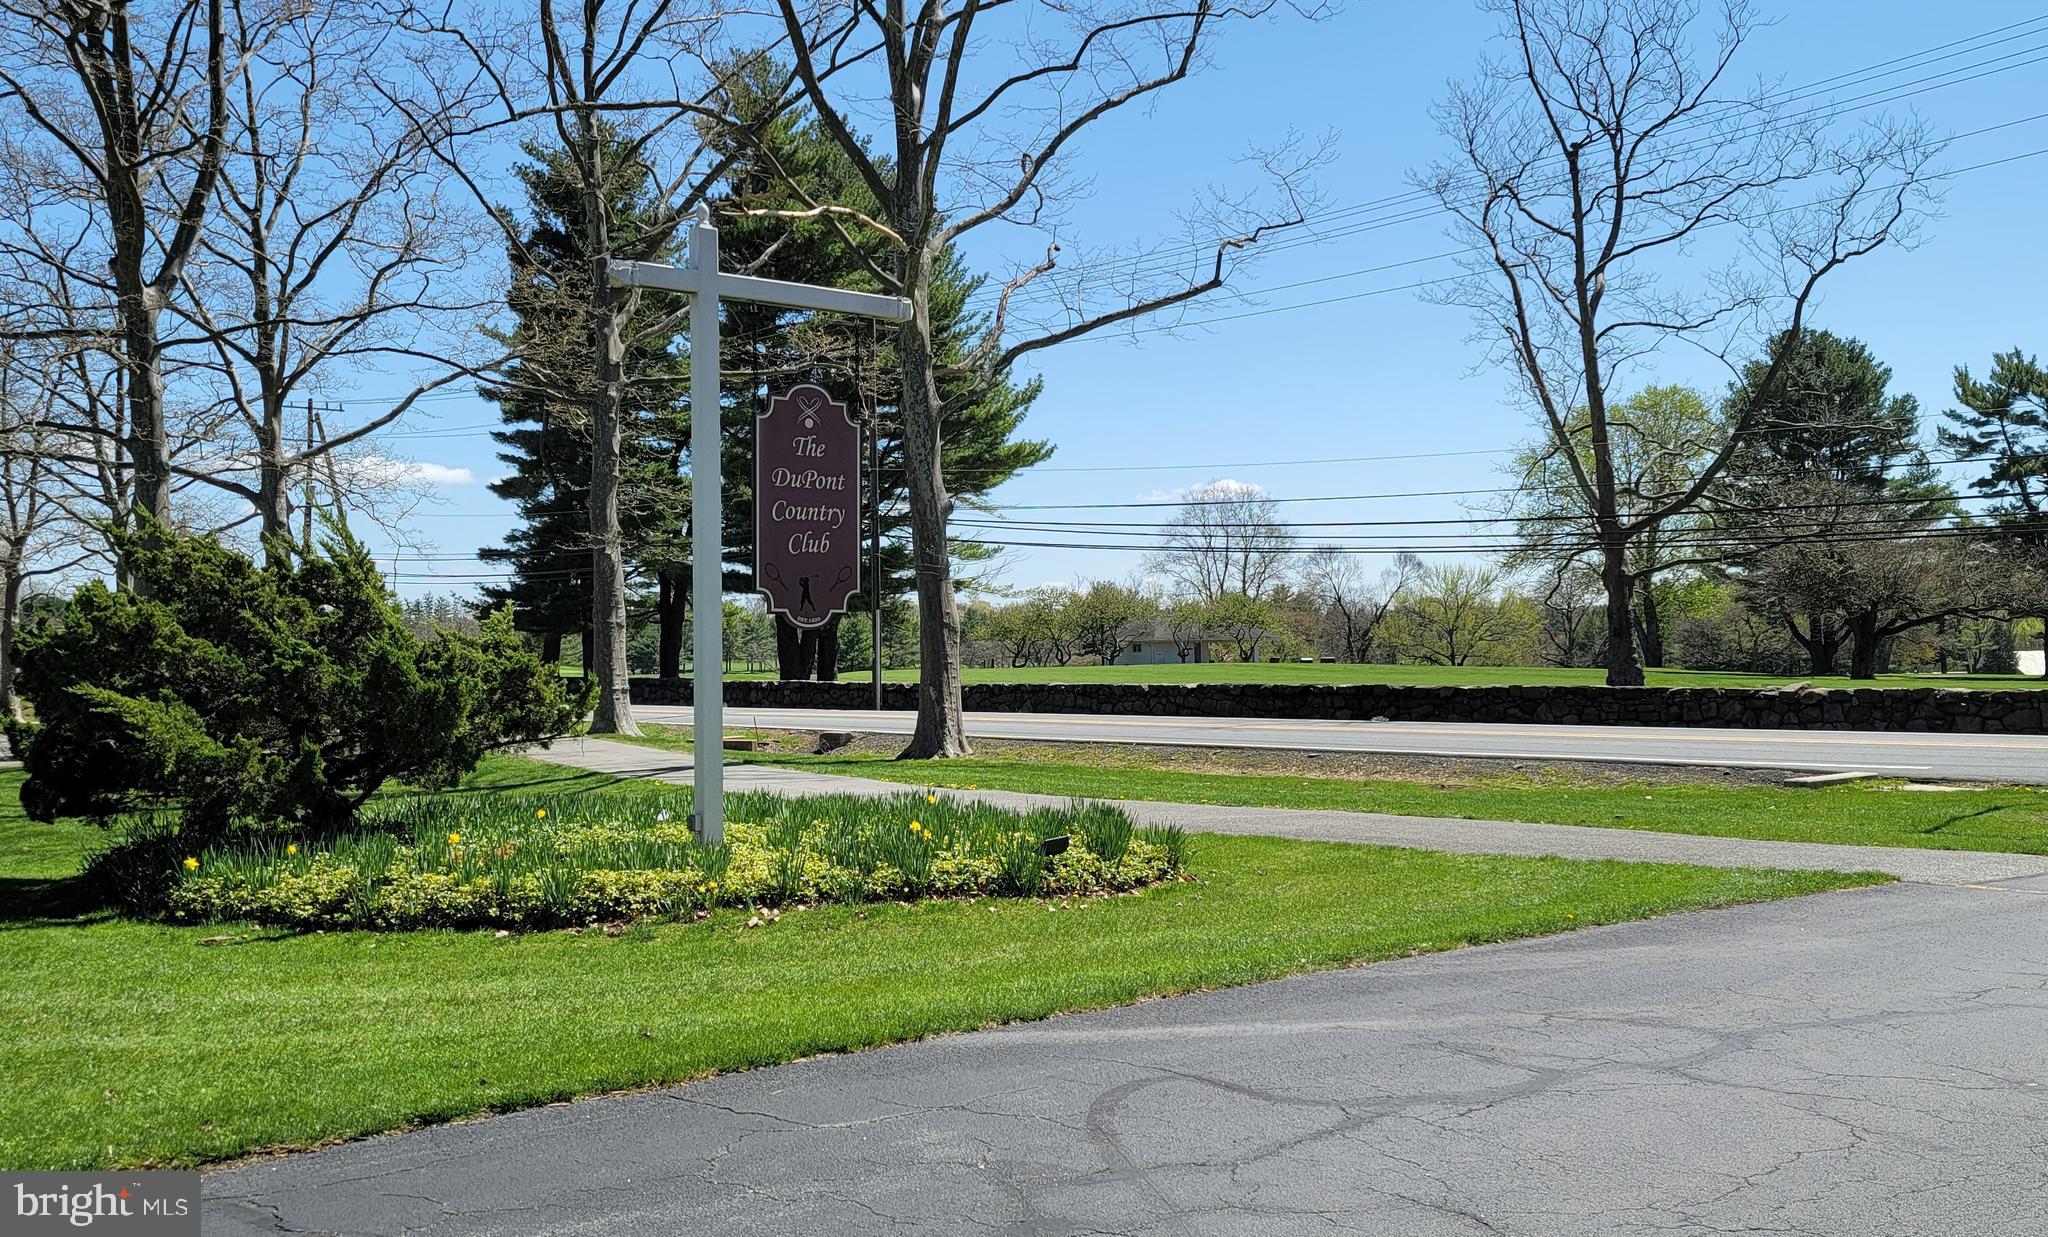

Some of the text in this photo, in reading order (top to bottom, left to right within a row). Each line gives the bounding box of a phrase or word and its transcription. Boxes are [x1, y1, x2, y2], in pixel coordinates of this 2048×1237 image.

[792, 435, 826, 457] The
[771, 467, 846, 490] DuPont
[771, 500, 846, 529] Country
[788, 531, 830, 554] Club
